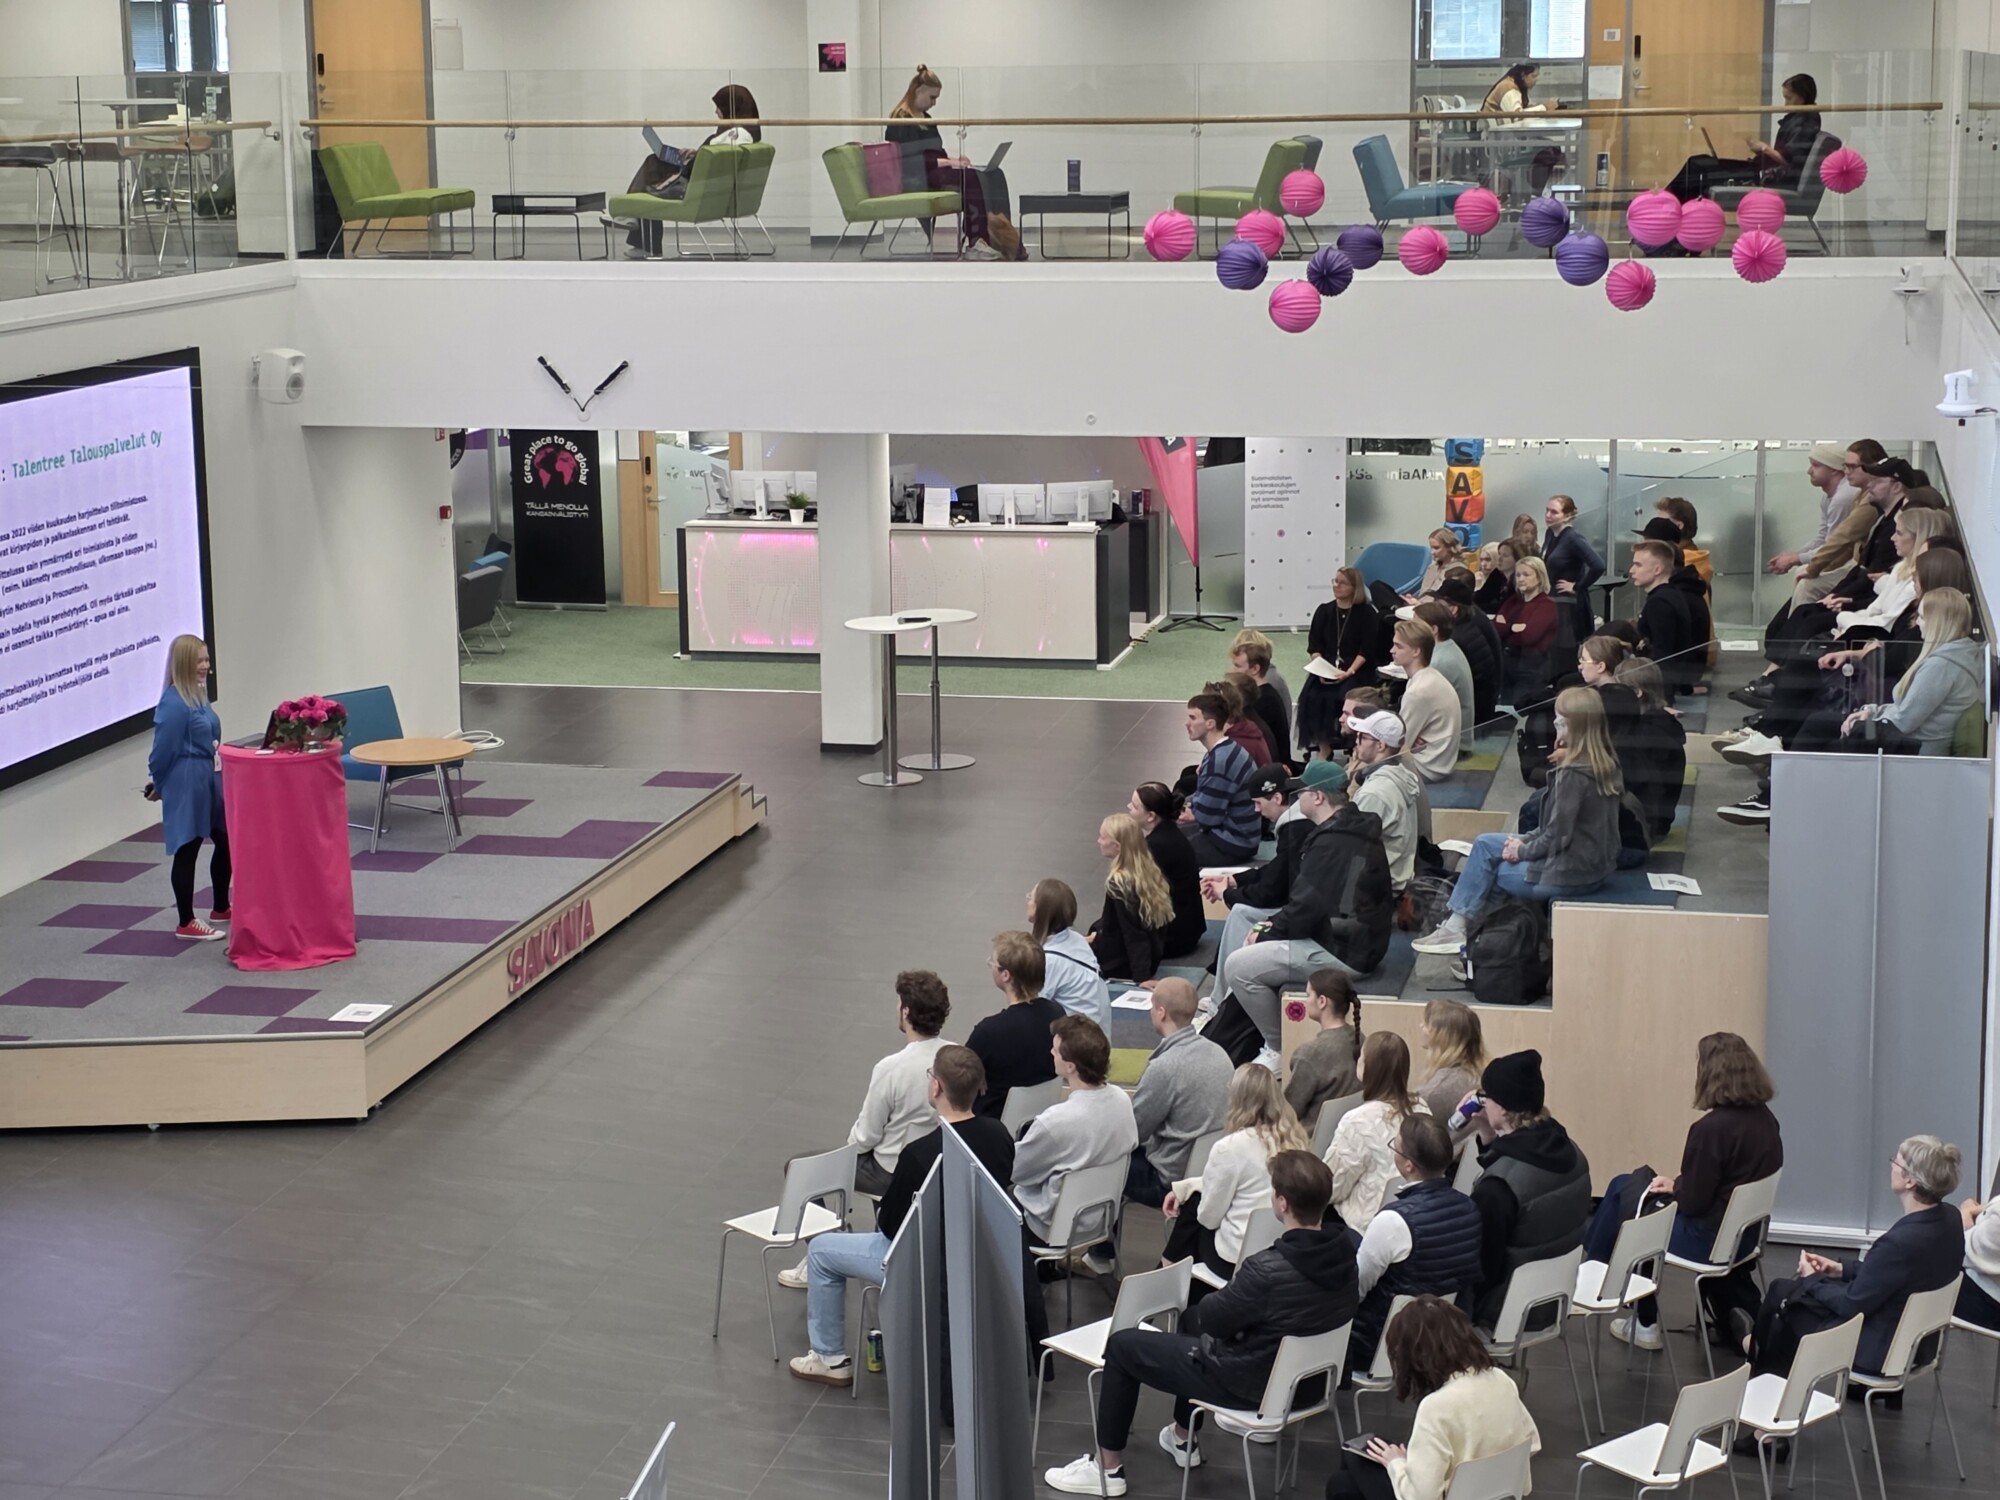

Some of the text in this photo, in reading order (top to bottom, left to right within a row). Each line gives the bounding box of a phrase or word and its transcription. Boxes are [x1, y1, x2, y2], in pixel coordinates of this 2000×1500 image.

[12, 430, 162, 479] Talentree Talouspalvelut Oy
[524, 435, 589, 486] Great place to go global
[12, 527, 25, 539] 2022
[28, 523, 44, 534] viiden
[46, 514, 77, 529] kuukauden
[78, 504, 109, 520] harjoittelun
[550, 503, 589, 511] MENOLLA
[10, 538, 43, 555] kirjanpidon
[44, 537, 50, 547] ja
[51, 524, 97, 544] palkanlaskennan
[98, 520, 106, 530] eri
[26, 560, 38, 571] sain
[40, 550, 73, 569] ymmärrystä
[74, 548, 82, 558] eri
[115, 537, 121, 548] ja
[22, 572, 50, 588] käännetty
[11, 621, 32, 635] todella
[33, 615, 50, 630] hyvää
[90, 598, 99, 609] Oli
[15, 596, 44, 612] Netvisoria
[45, 594, 51, 605] ja
[11, 636, 35, 651] osannut
[94, 613, 107, 624] apua
[45, 667, 73, 682] kannattaa
[74, 658, 93, 672] kysellä
[94, 653, 108, 664] myös
[6, 690, 48, 711] harjoittelijoita
[49, 685, 57, 696] tai
[507, 897, 595, 993] SAVONIA
